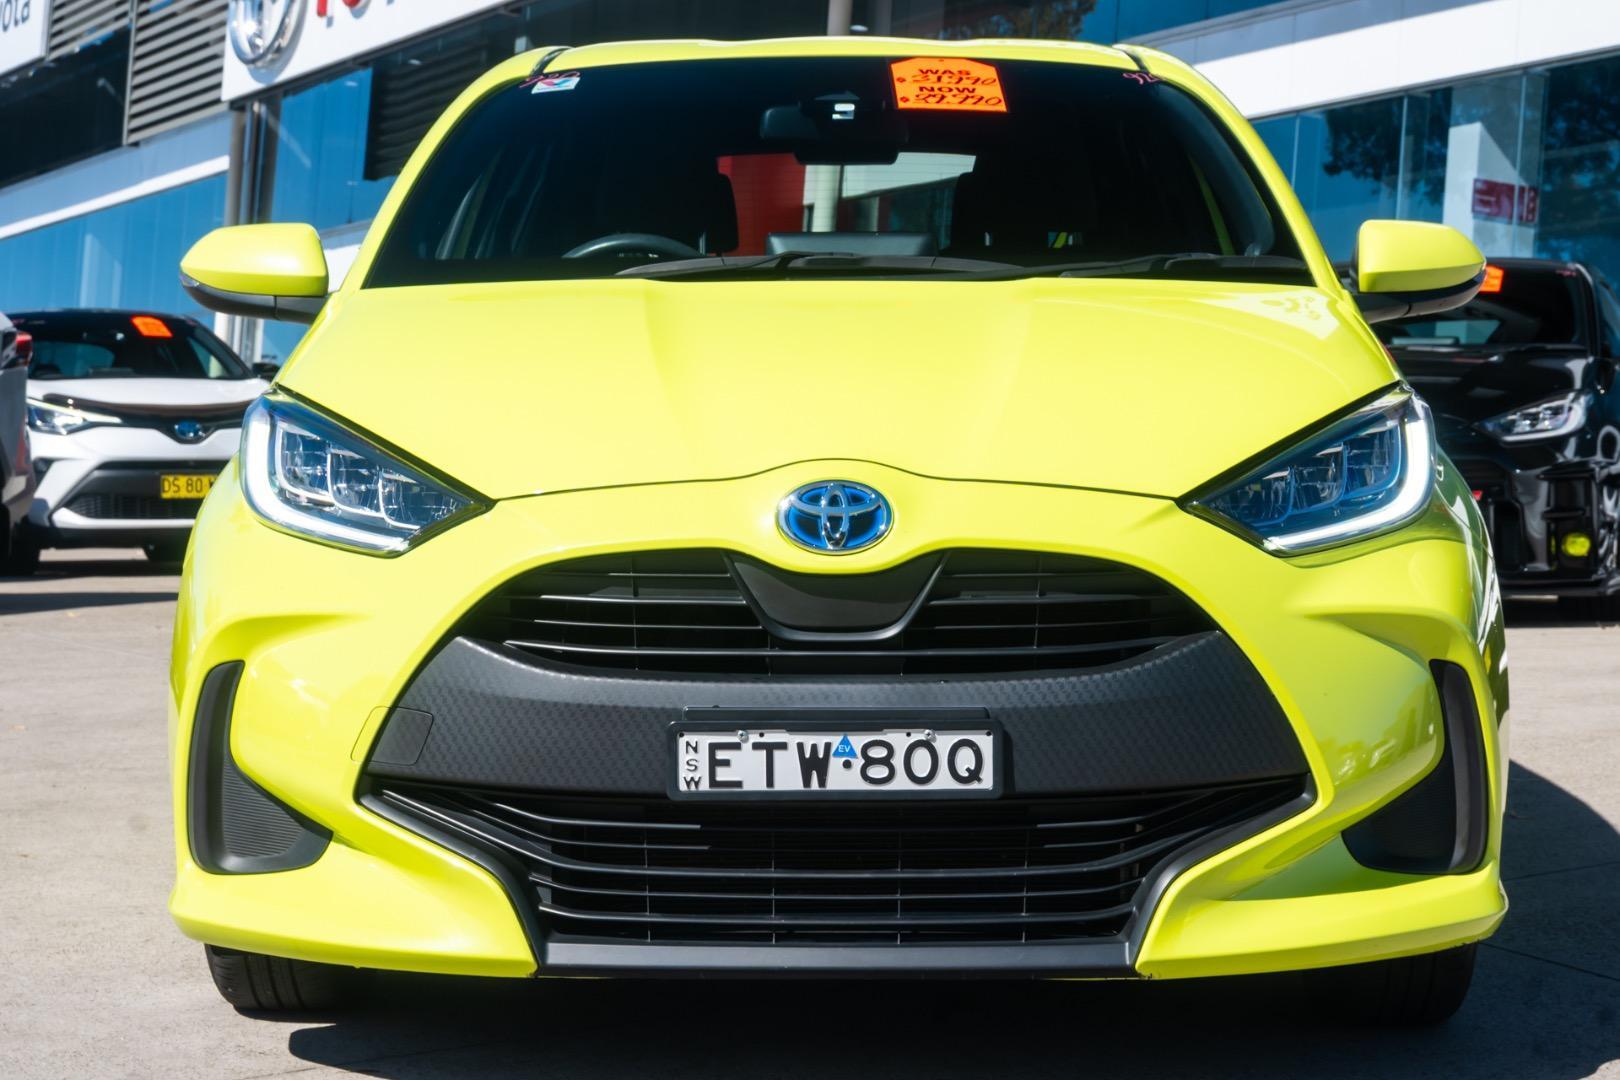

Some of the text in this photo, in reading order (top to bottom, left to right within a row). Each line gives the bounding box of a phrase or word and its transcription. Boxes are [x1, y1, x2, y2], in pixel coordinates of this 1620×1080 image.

[918, 86, 977, 94] NOW
[186, 477, 203, 493] 80
[838, 744, 851, 752] EV
[684, 740, 702, 790] NSW
